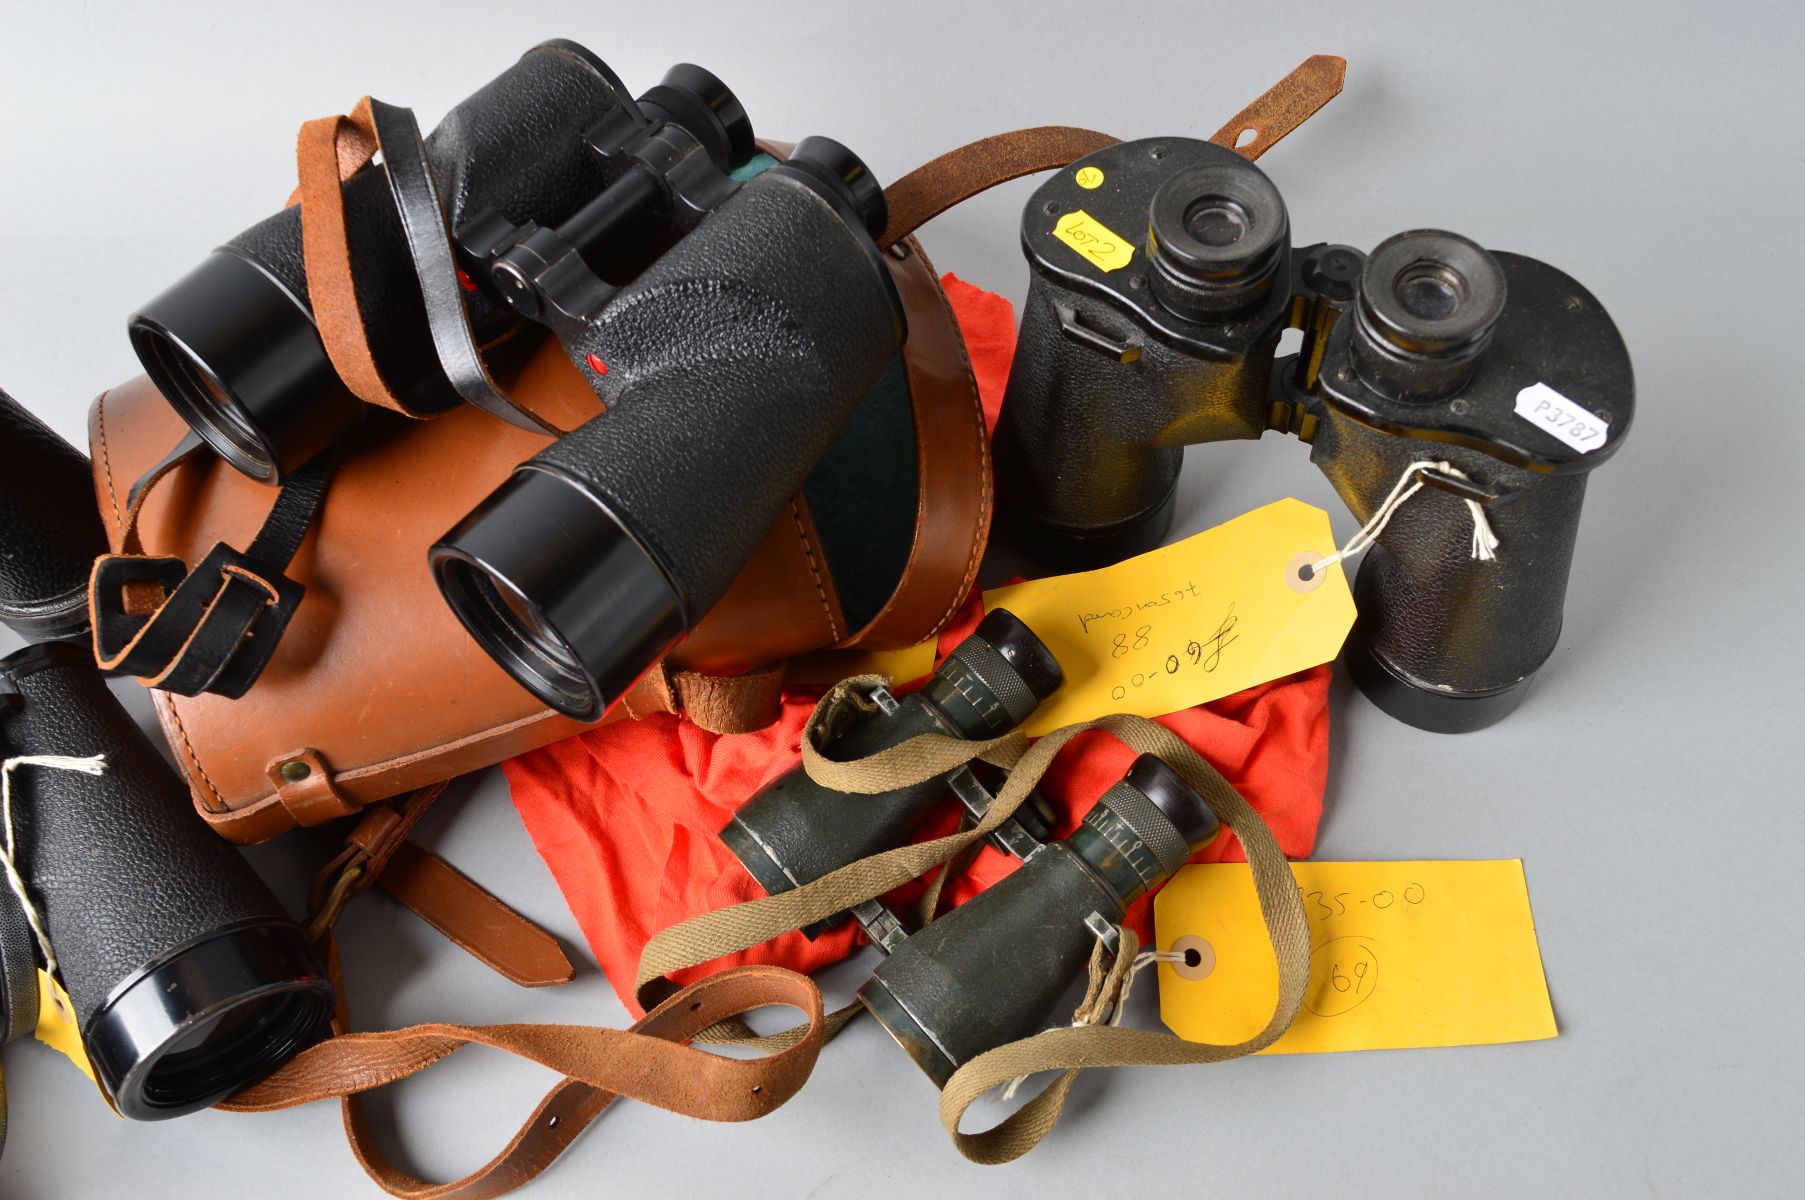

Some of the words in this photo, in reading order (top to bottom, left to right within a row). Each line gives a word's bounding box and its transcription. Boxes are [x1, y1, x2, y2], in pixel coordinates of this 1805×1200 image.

[1088, 242, 1116, 262] 2
[1534, 400, 1599, 441] P3787
[1111, 625, 1151, 658] 88
[1298, 883, 1424, 921] 35-00
[1332, 962, 1368, 995] 69
